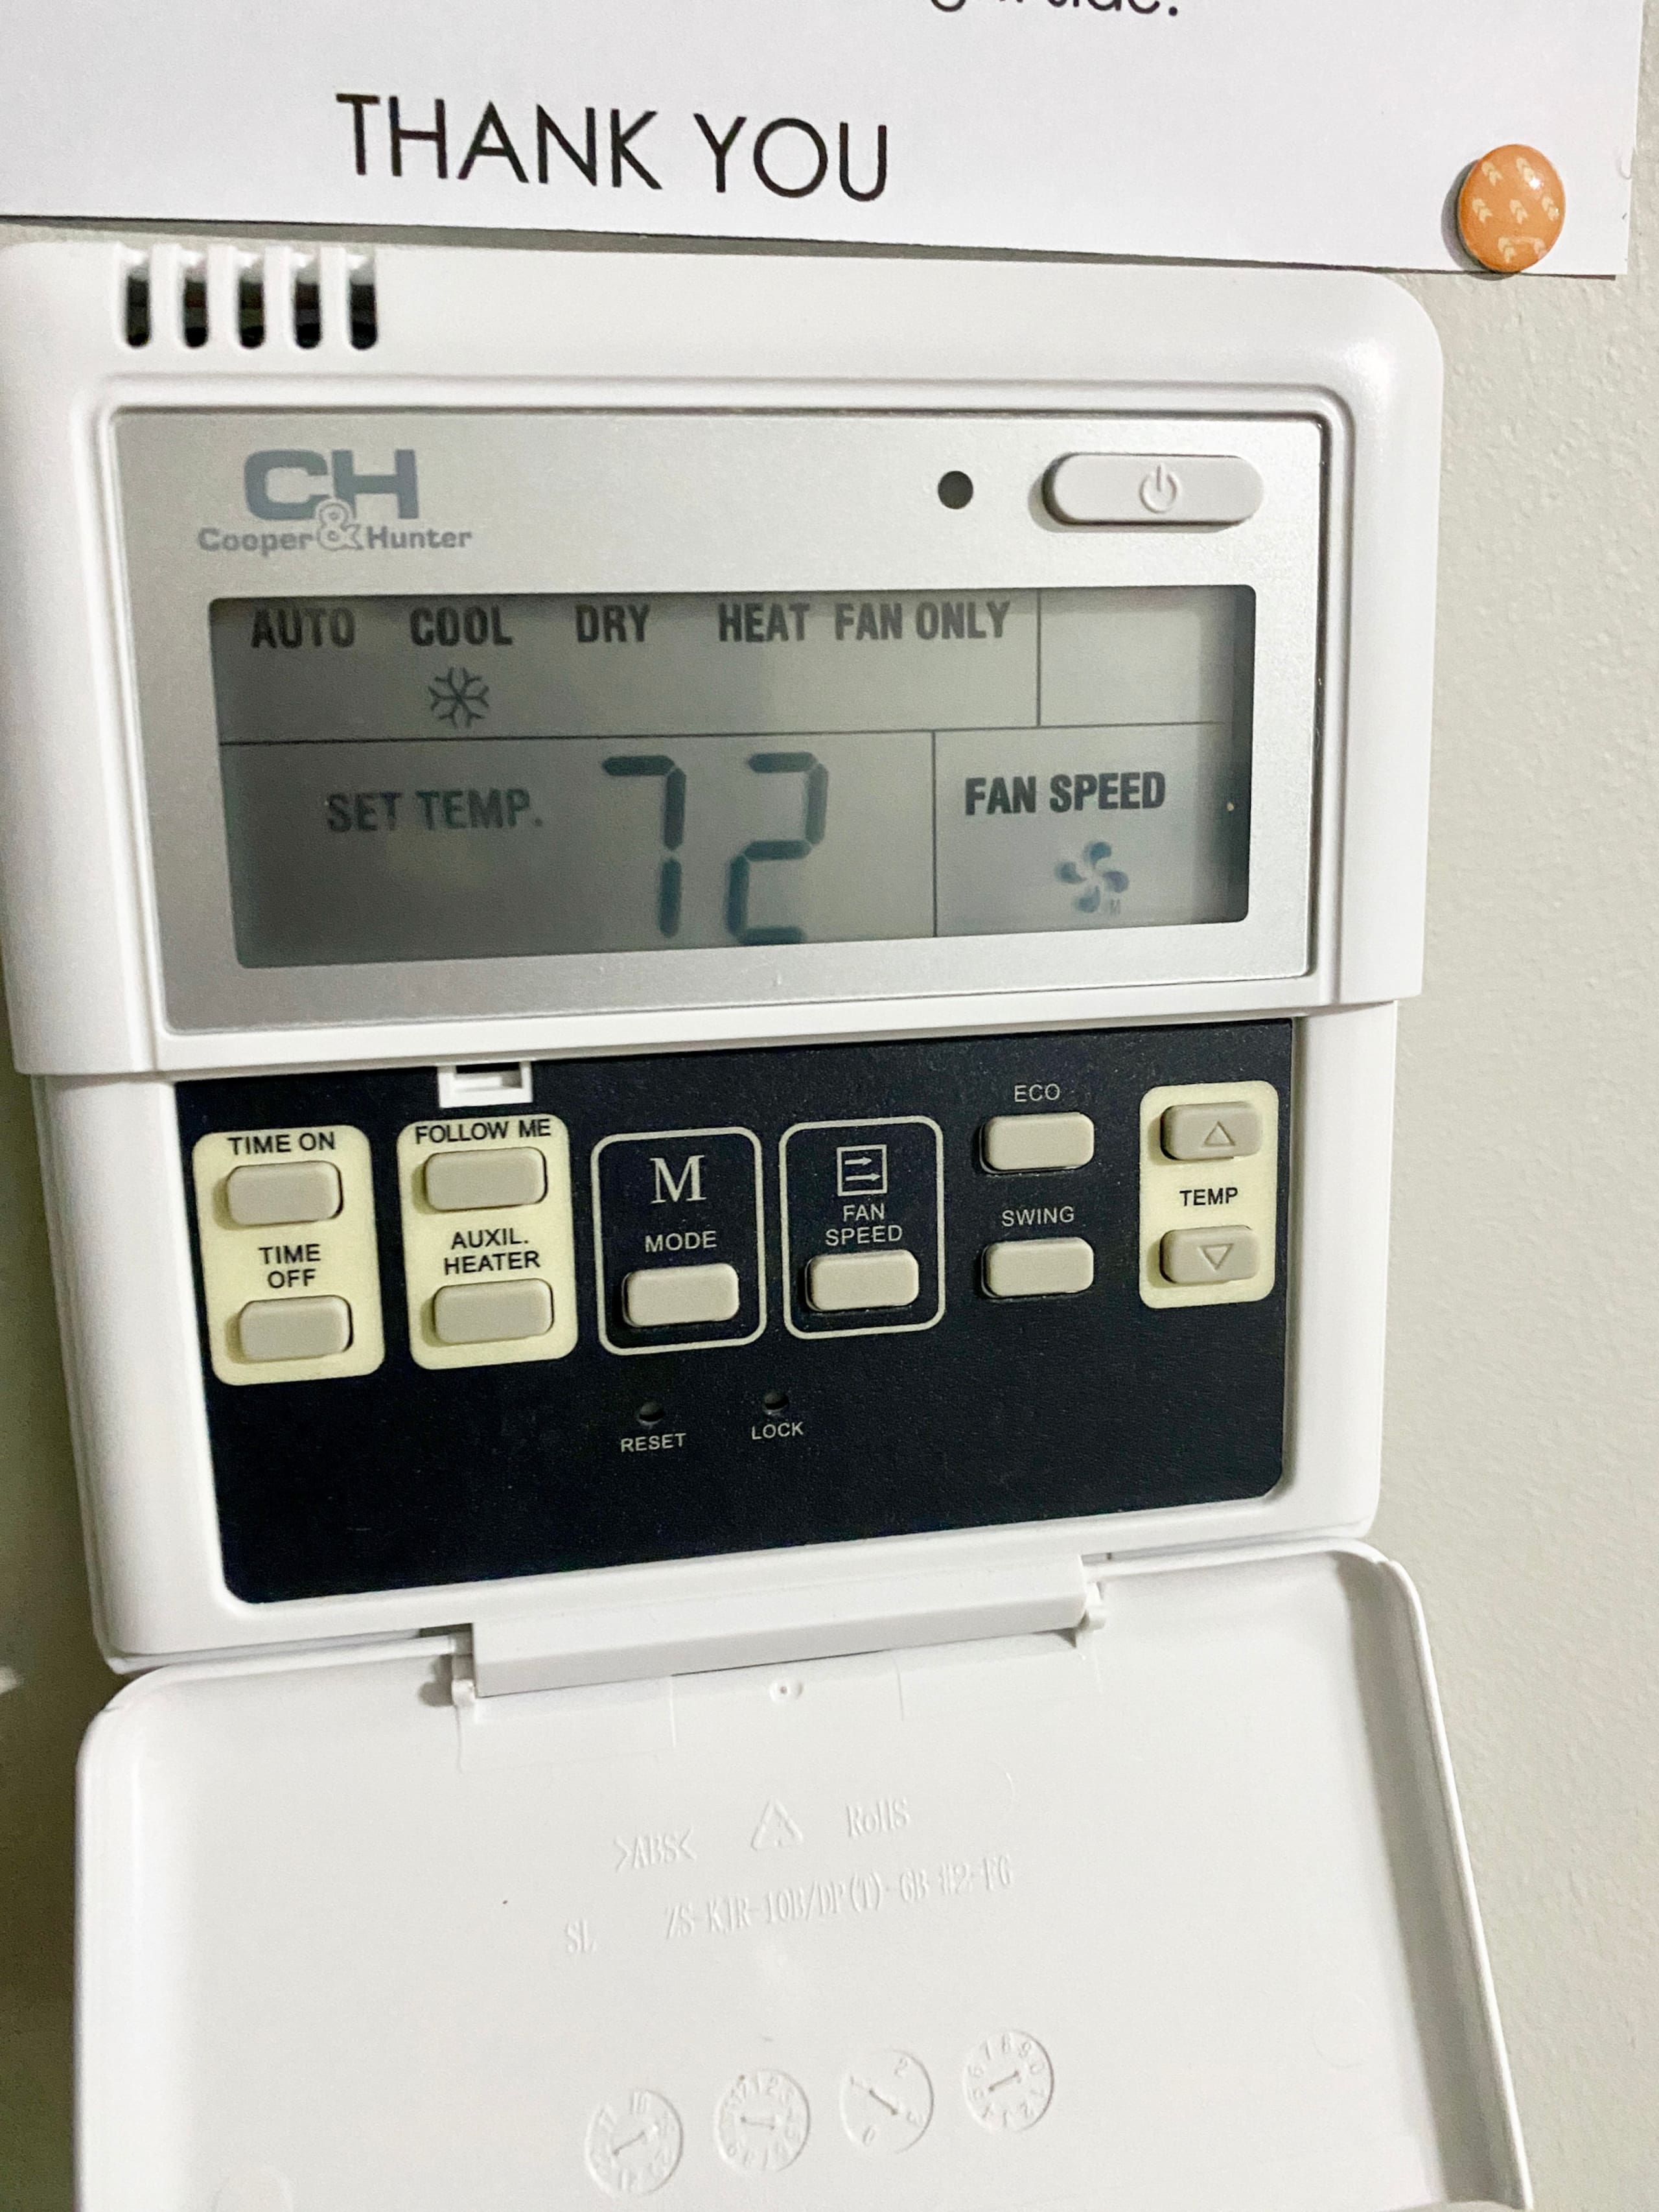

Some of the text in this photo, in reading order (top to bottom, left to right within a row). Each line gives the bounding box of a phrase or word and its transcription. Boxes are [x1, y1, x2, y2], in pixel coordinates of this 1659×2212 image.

[336, 93, 889, 202] THANK YOU
[242, 448, 421, 520] CH
[198, 526, 314, 557] Cooper
[365, 526, 473, 550] Hunter
[250, 607, 356, 649] AUTO
[409, 605, 513, 647] COOL
[575, 602, 650, 644] DRY
[717, 602, 810, 643] HEAT
[834, 600, 1011, 641] FAN ONLY
[964, 771, 1166, 816] FAN SPEED
[326, 788, 544, 833] SET TEMP.
[601, 751, 830, 945] 72
[1014, 1082, 1061, 1103] ECO
[227, 1131, 336, 1156] TIME ON
[414, 1118, 551, 1145] FOLLOW ME
[649, 1154, 707, 1204] M
[1179, 1186, 1239, 1207] TEMP
[842, 1203, 886, 1222] FAN
[1001, 1205, 1075, 1228] SWING
[450, 1227, 529, 1250] AUXIL.
[644, 1230, 718, 1253] MODE
[824, 1224, 903, 1247] SPEED
[259, 1243, 321, 1265] TIME
[443, 1250, 541, 1276] HEATER
[267, 1268, 317, 1289] OFF
[620, 1432, 687, 1452] RESET
[751, 1421, 804, 1441] LOCK
